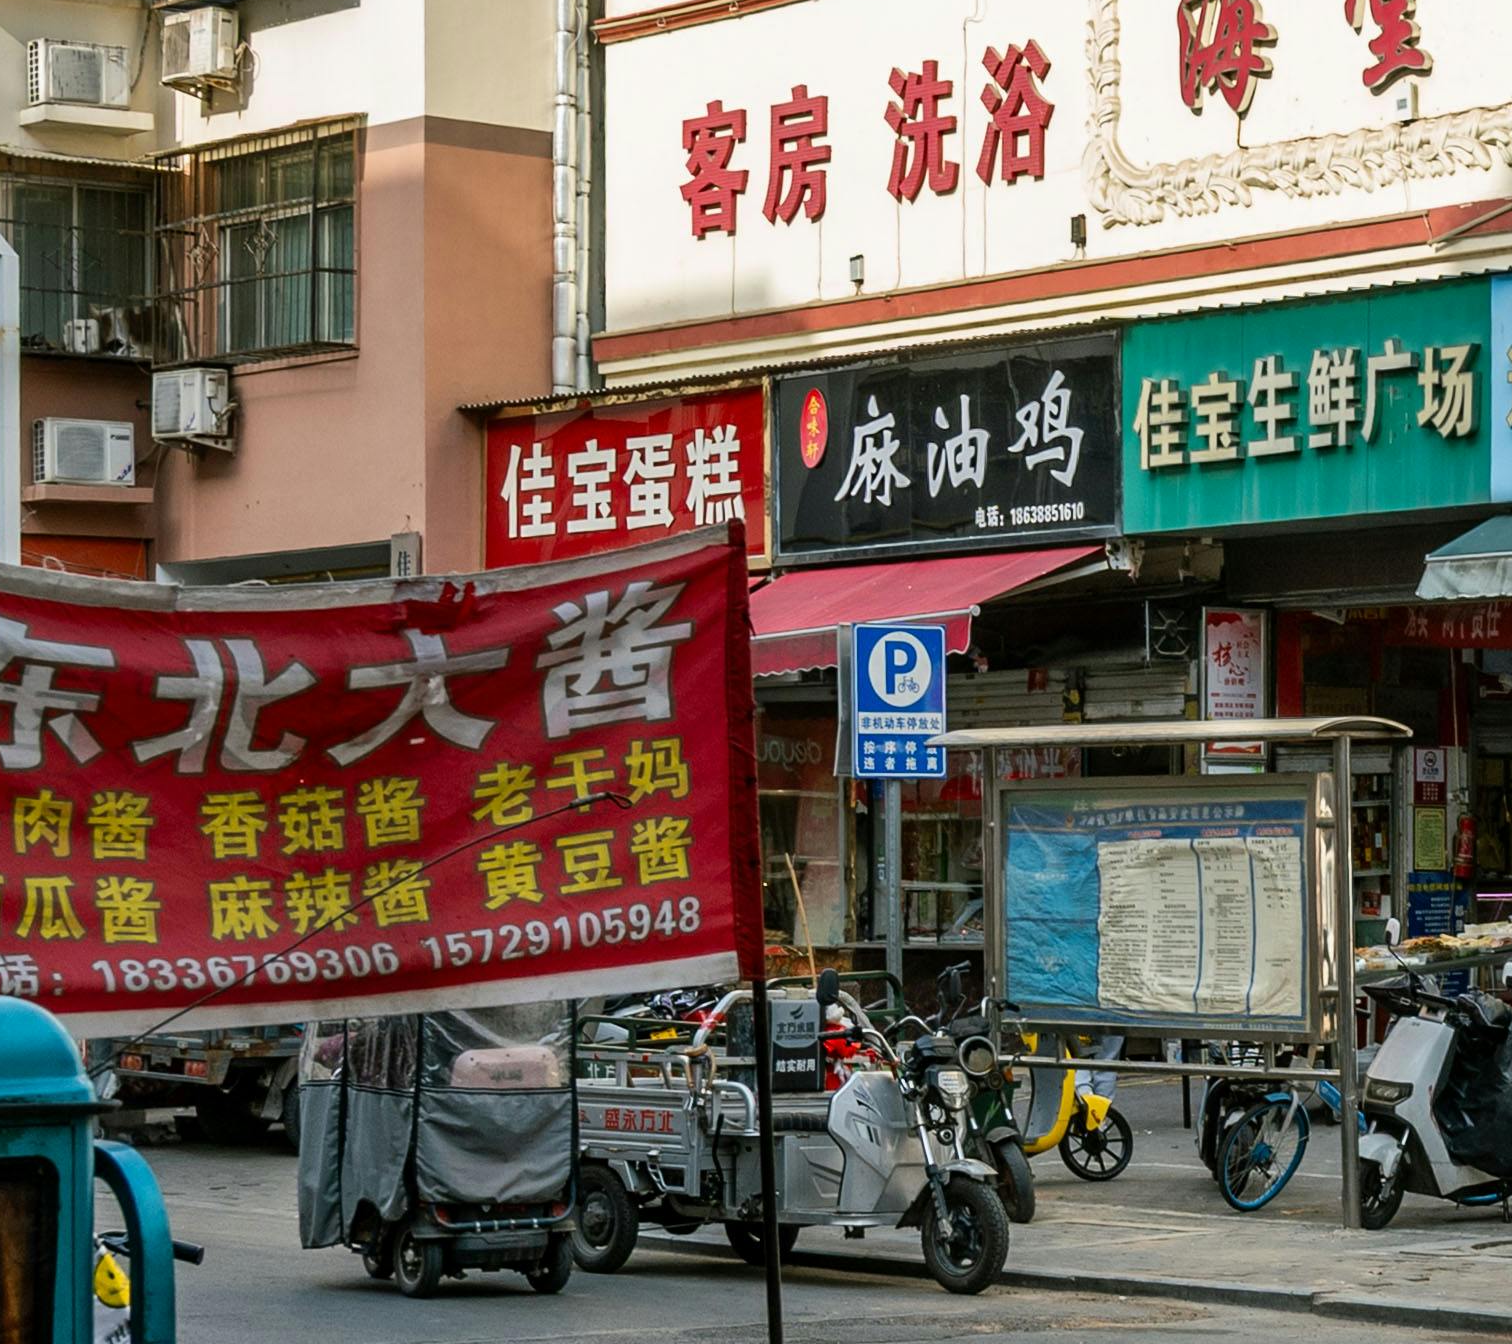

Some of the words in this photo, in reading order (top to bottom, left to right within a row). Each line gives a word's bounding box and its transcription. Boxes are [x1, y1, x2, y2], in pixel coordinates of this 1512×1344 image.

[680, 86, 832, 239] 客房
[885, 41, 1055, 203] 洗浴
[834, 370, 1086, 508] 麻油鸡
[1133, 339, 1481, 471] 佳宝生鲜广场
[501, 423, 746, 539] 佳宝蛋糕
[861, 716, 941, 731] 非机动车停放处
[884, 640, 918, 695] P
[200, 775, 427, 861] 香菇酱
[471, 736, 691, 828] 老干妈
[207, 860, 433, 943] 麻辣酱
[478, 815, 694, 912] 黄豆酱
[91, 943, 399, 995] 18336769306
[420, 896, 702, 971] 15729105948
[775, 1058, 816, 1072] 结实耐用
